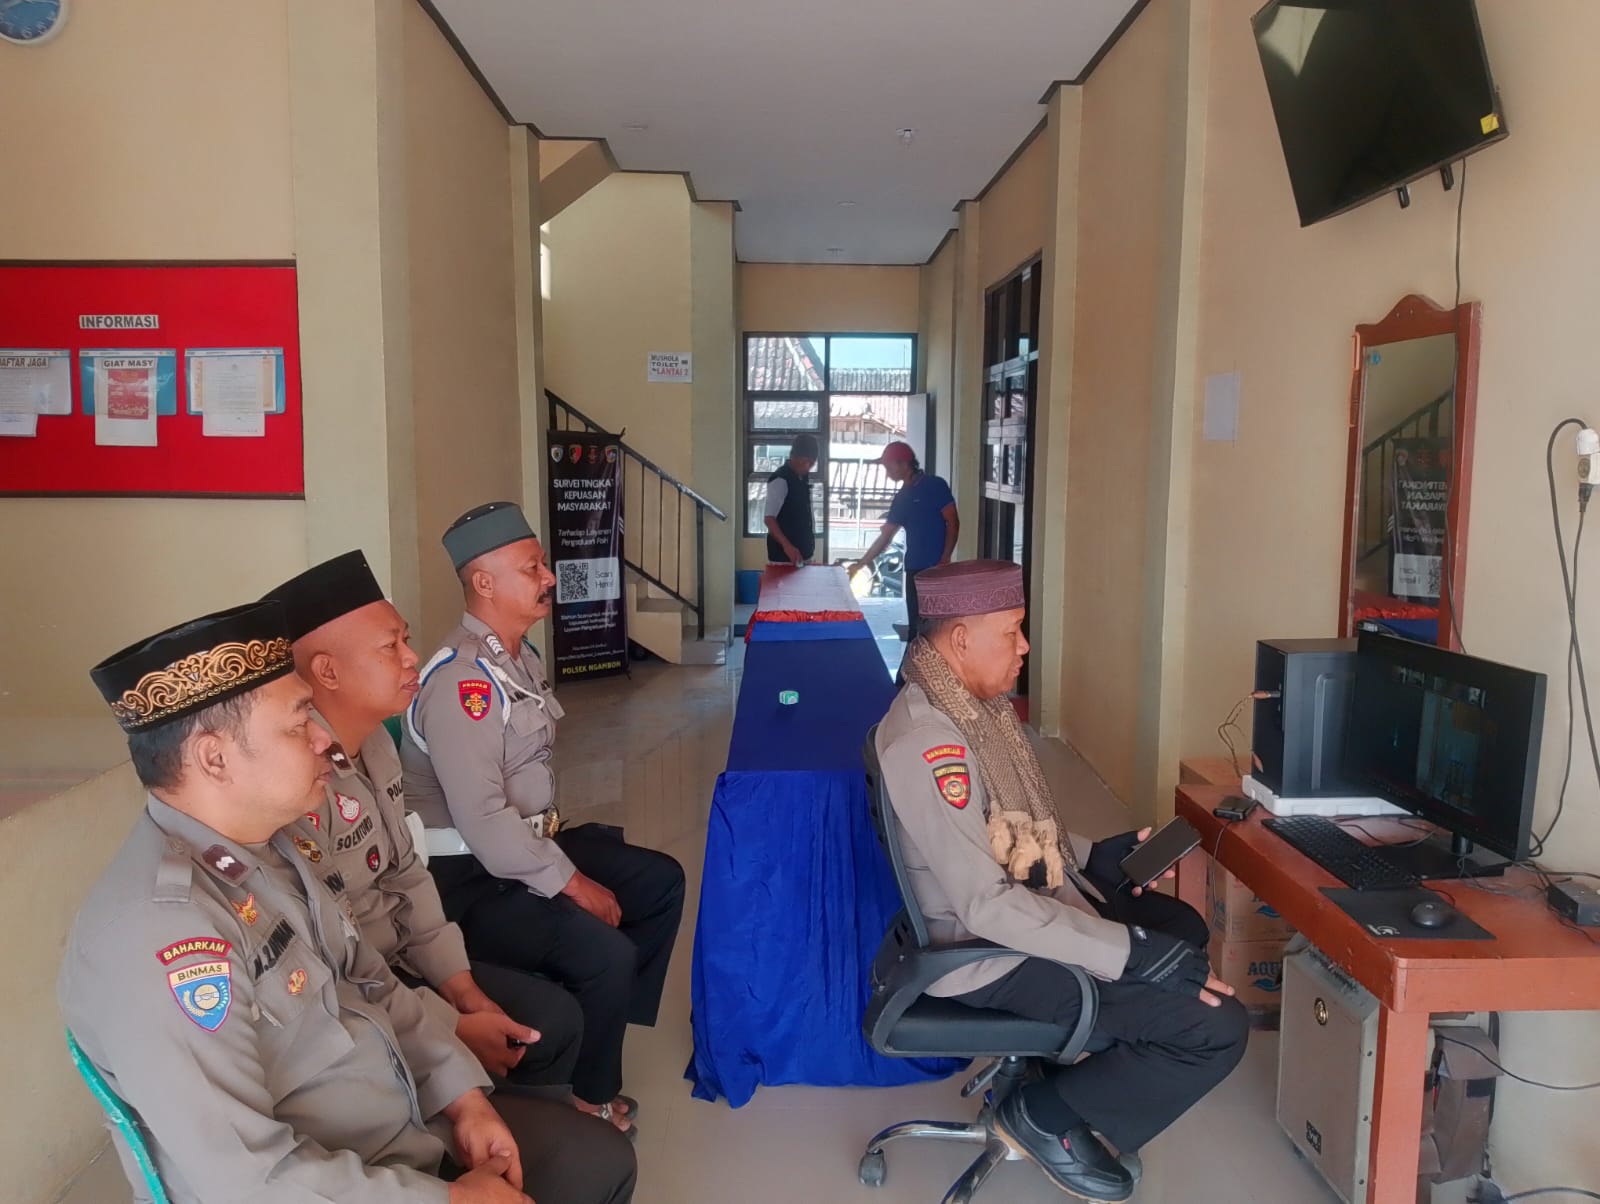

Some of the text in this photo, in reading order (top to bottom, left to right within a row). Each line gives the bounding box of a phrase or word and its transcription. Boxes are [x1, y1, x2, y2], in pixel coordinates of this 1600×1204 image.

[81, 315, 157, 328] INFORMASI
[0, 358, 47, 368] AFTAR JAGA
[553, 479, 580, 488] SURVEI
[564, 490, 606, 500] KEPUASAN
[557, 502, 611, 512] MASYARAKAT
[162, 941, 226, 961] BAHARKAM
[177, 964, 223, 982] BINMAS
